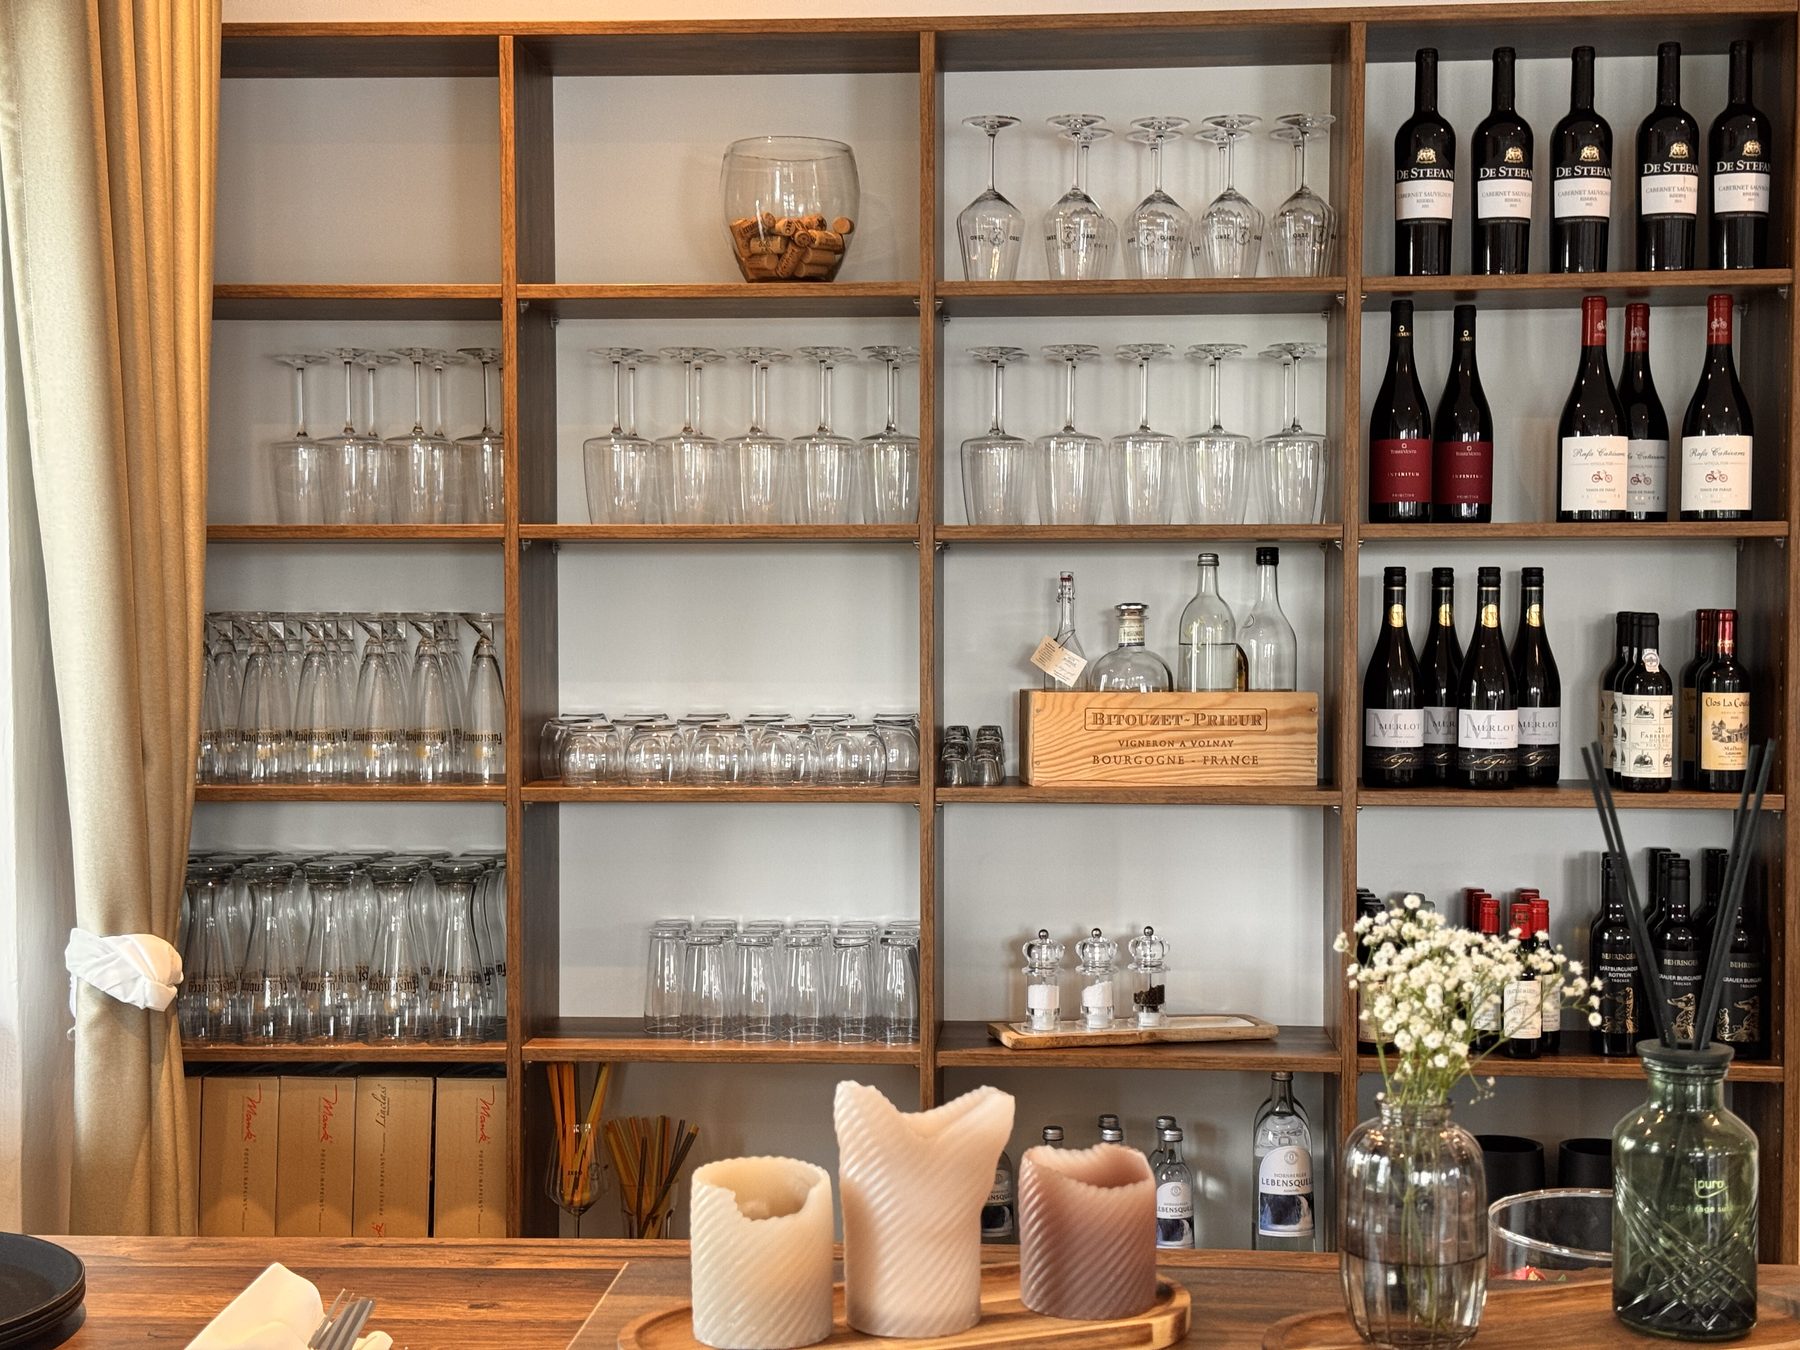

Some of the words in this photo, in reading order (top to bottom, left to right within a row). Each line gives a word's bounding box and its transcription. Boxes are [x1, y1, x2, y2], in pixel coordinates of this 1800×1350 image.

[1556, 167, 1572, 178] DE
[1644, 163, 1660, 175] DE
[1717, 161, 1734, 173] DE
[1397, 169, 1409, 180] DE
[1480, 168, 1496, 179] DE
[1705, 697, 1721, 707] Clos
[1723, 698, 1733, 707] La
[1091, 712, 1263, 727] BITOUZET-PRIEUR
[1379, 723, 1421, 731] MERLOT
[1473, 724, 1515, 732] MERLOT
[1118, 740, 1175, 748] VIGNERON
[1190, 740, 1235, 748] VOLNAY
[1092, 755, 1185, 765] BOURGOGNE
[1202, 755, 1260, 765] FRANCE
